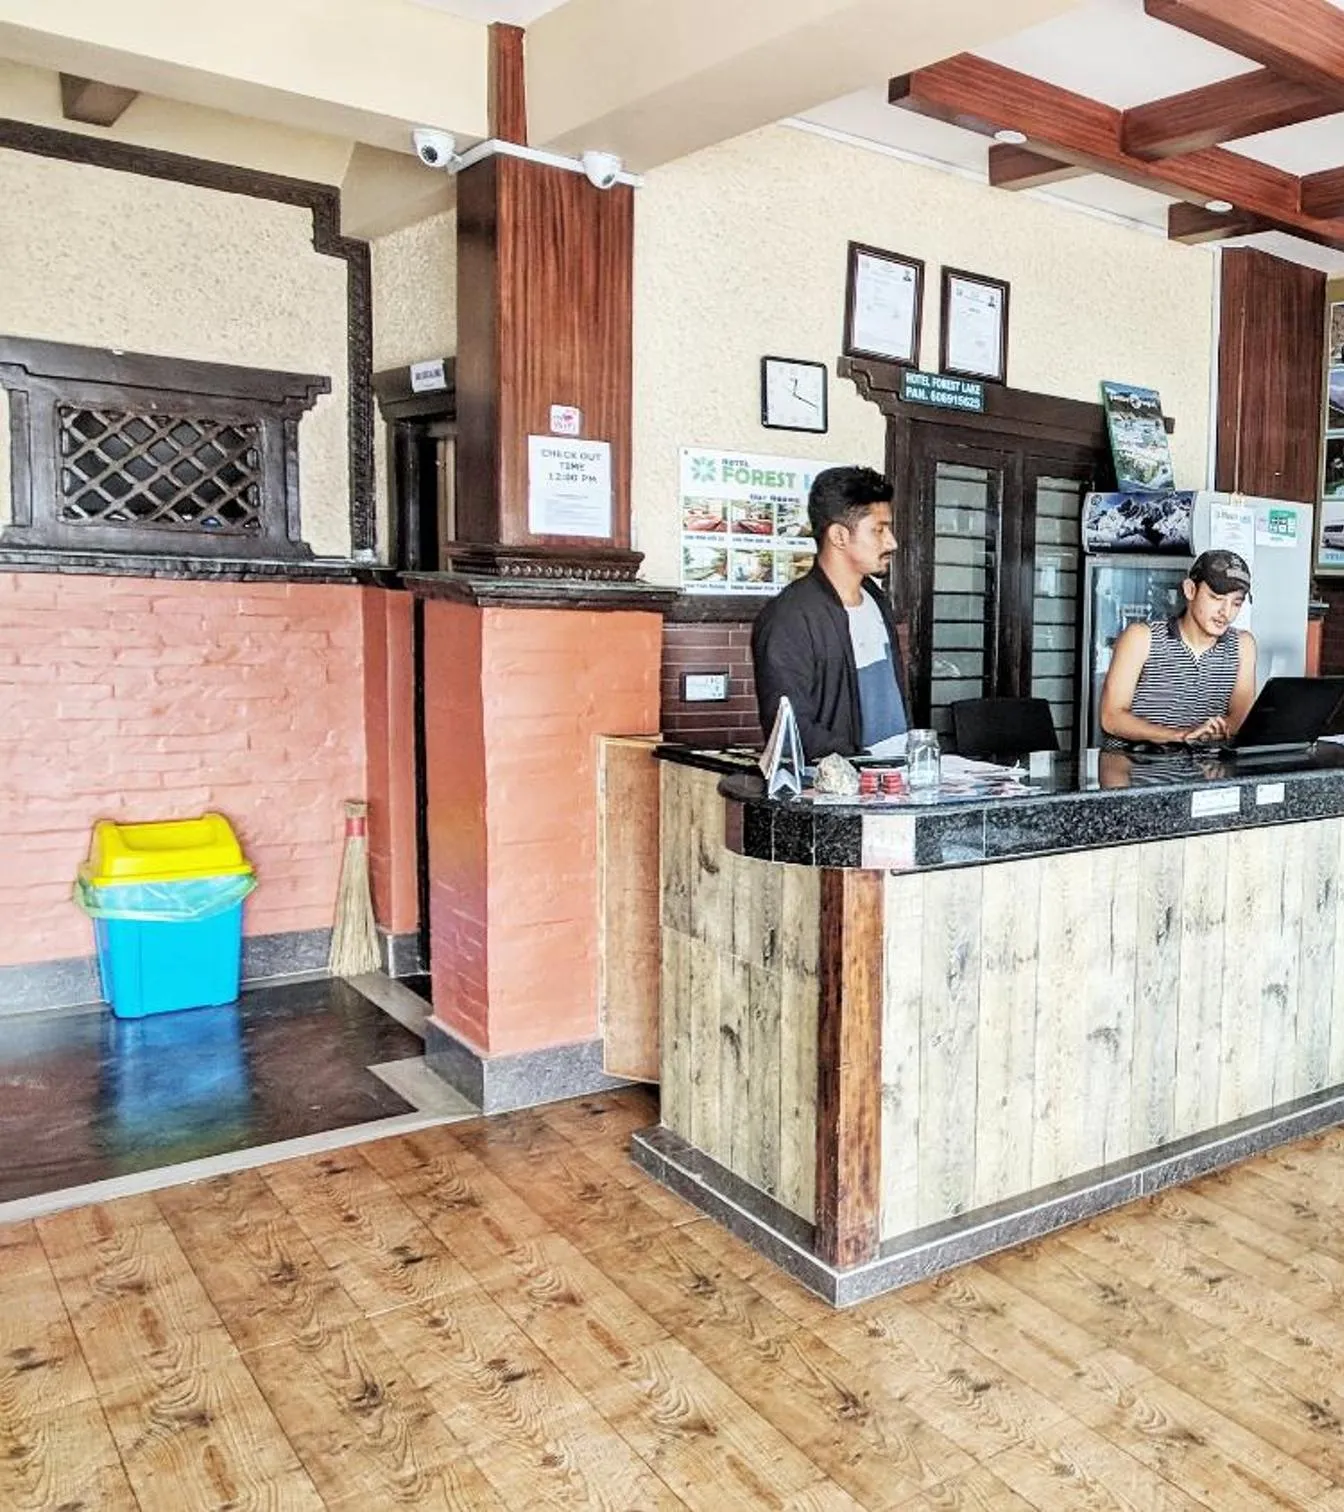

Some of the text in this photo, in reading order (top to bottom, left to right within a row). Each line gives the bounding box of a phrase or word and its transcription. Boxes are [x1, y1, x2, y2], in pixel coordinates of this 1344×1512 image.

[905, 372, 981, 395] HOTEL FOREST LAKE
[541, 449, 602, 461] CHECK OUT
[560, 461, 585, 472] TIME
[581, 473, 597, 483] PM
[721, 466, 797, 489] FOREST
